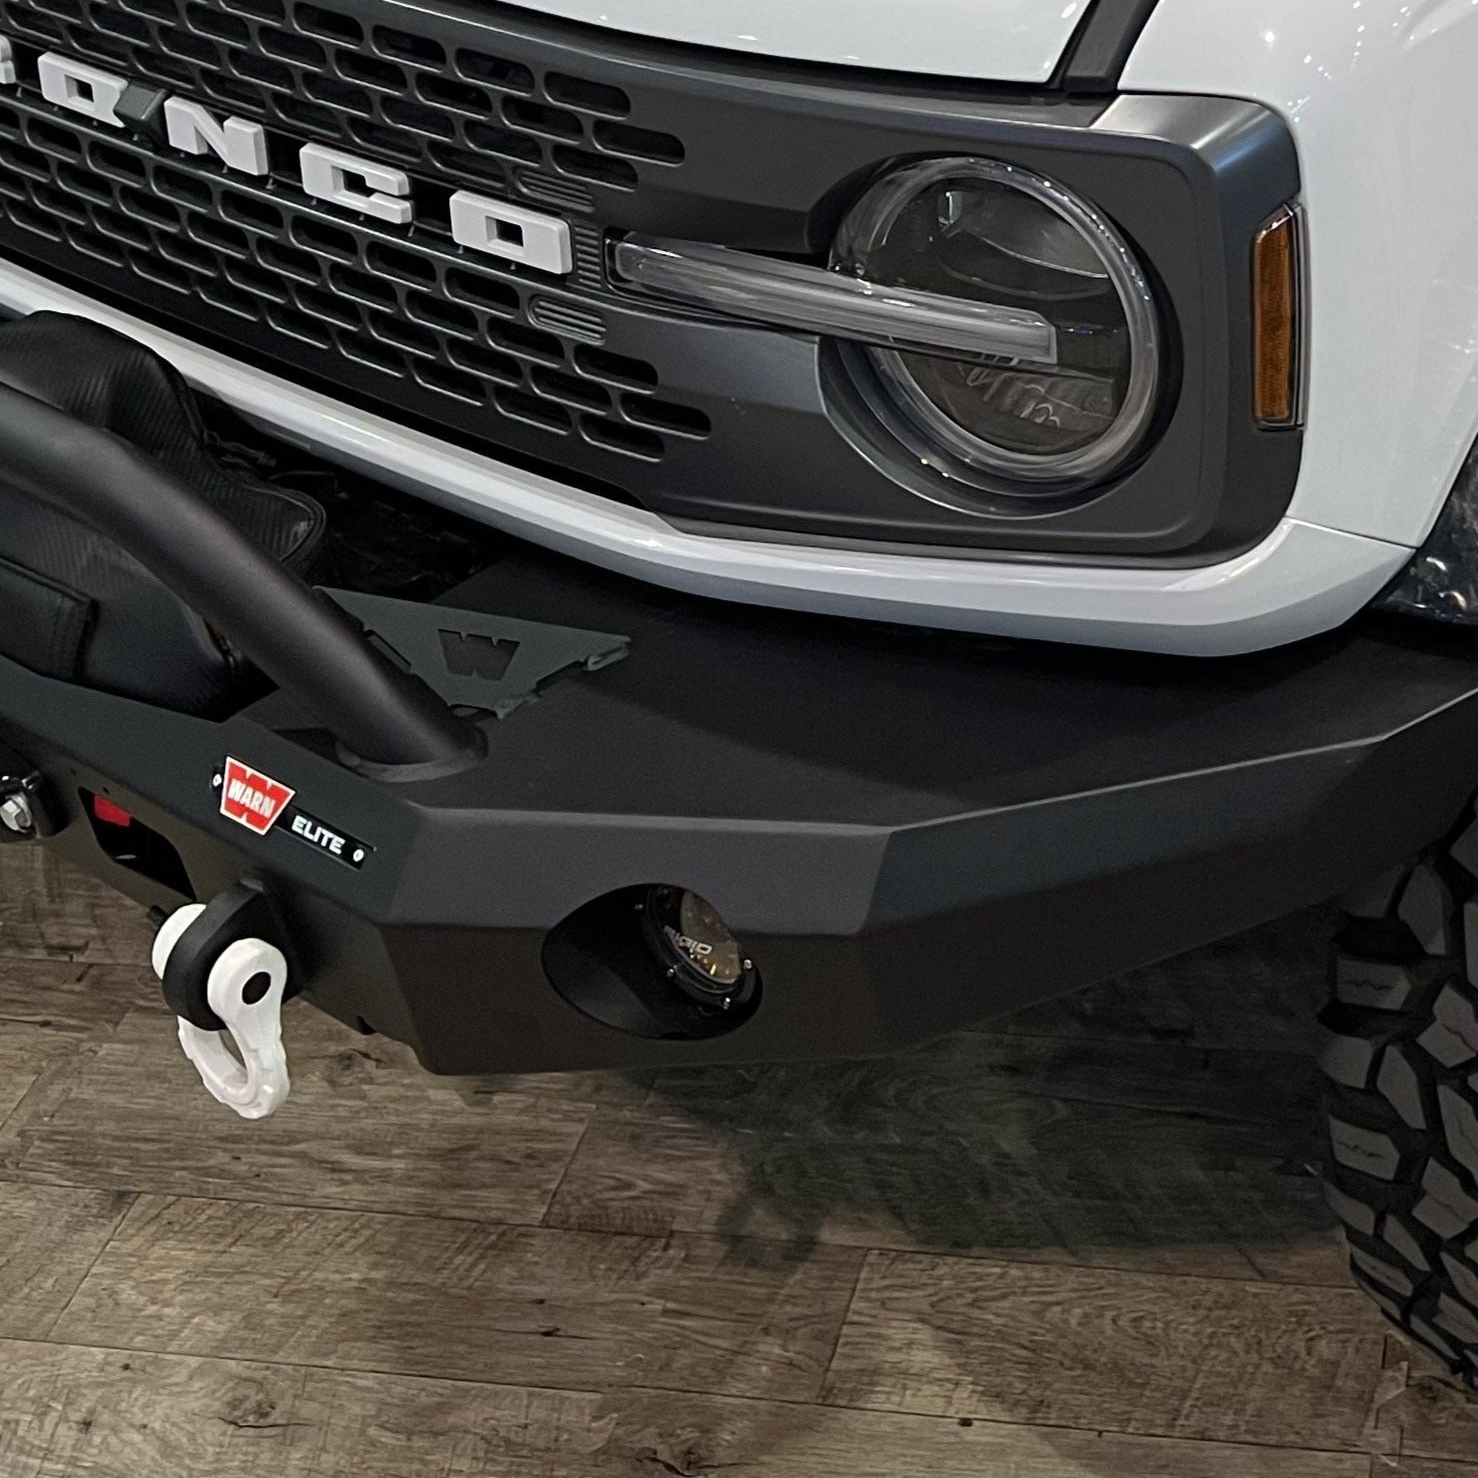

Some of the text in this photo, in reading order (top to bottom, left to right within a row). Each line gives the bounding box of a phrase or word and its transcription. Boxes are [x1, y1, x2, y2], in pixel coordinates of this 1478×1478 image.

[0, 34, 573, 276] ONCO
[227, 777, 276, 819] WARN
[291, 814, 346, 855] ELITE
